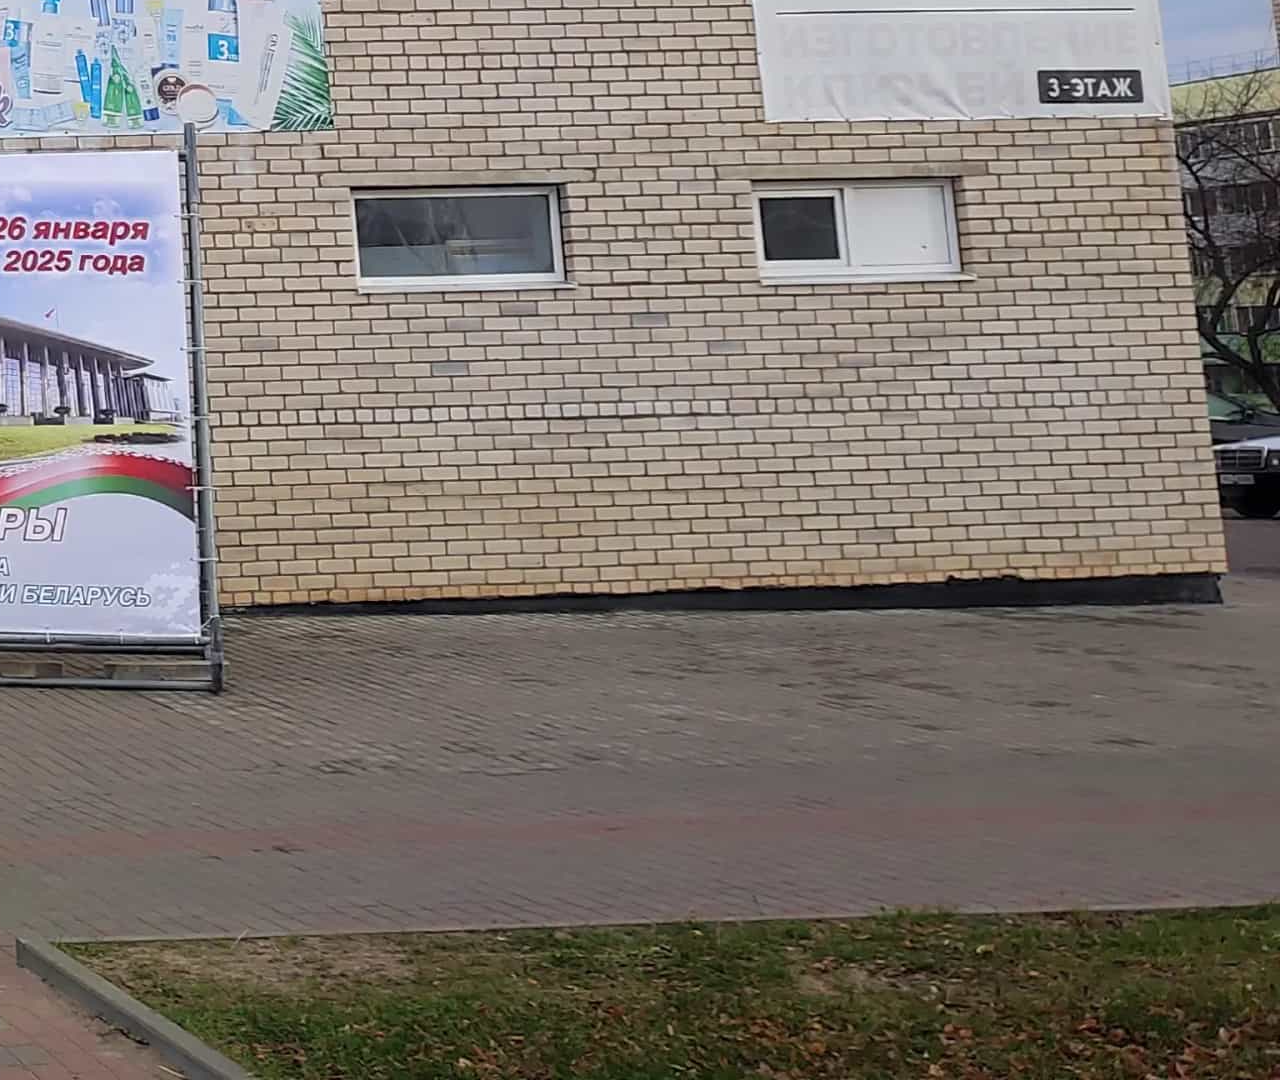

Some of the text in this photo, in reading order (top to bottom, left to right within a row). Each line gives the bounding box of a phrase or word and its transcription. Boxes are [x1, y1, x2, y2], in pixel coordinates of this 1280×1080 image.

[1047, 77, 1135, 99] 3-ЭТАЖ
[32, 217, 149, 241] января
[4, 249, 146, 275] 2025 года
[20, 584, 152, 608] БЕЛАРУСЬ
